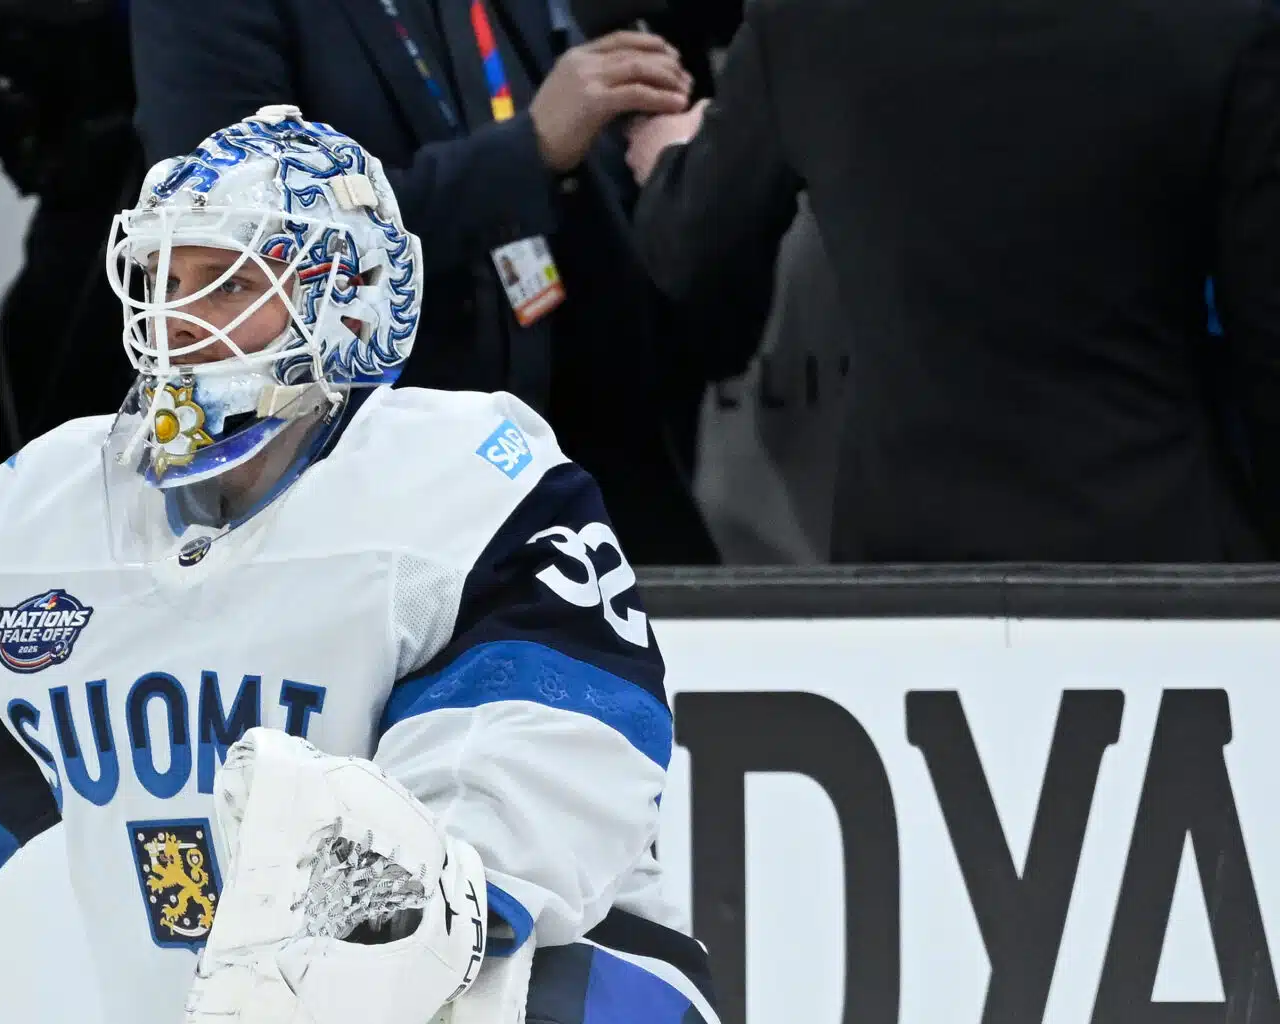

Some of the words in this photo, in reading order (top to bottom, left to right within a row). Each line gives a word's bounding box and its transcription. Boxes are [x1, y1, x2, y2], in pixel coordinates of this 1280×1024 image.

[487, 428, 528, 471] SAP
[525, 521, 649, 648] 32
[0, 610, 89, 629] NATIONS
[1, 627, 74, 643] FACE-OFF
[18, 645, 38, 653] 2025
